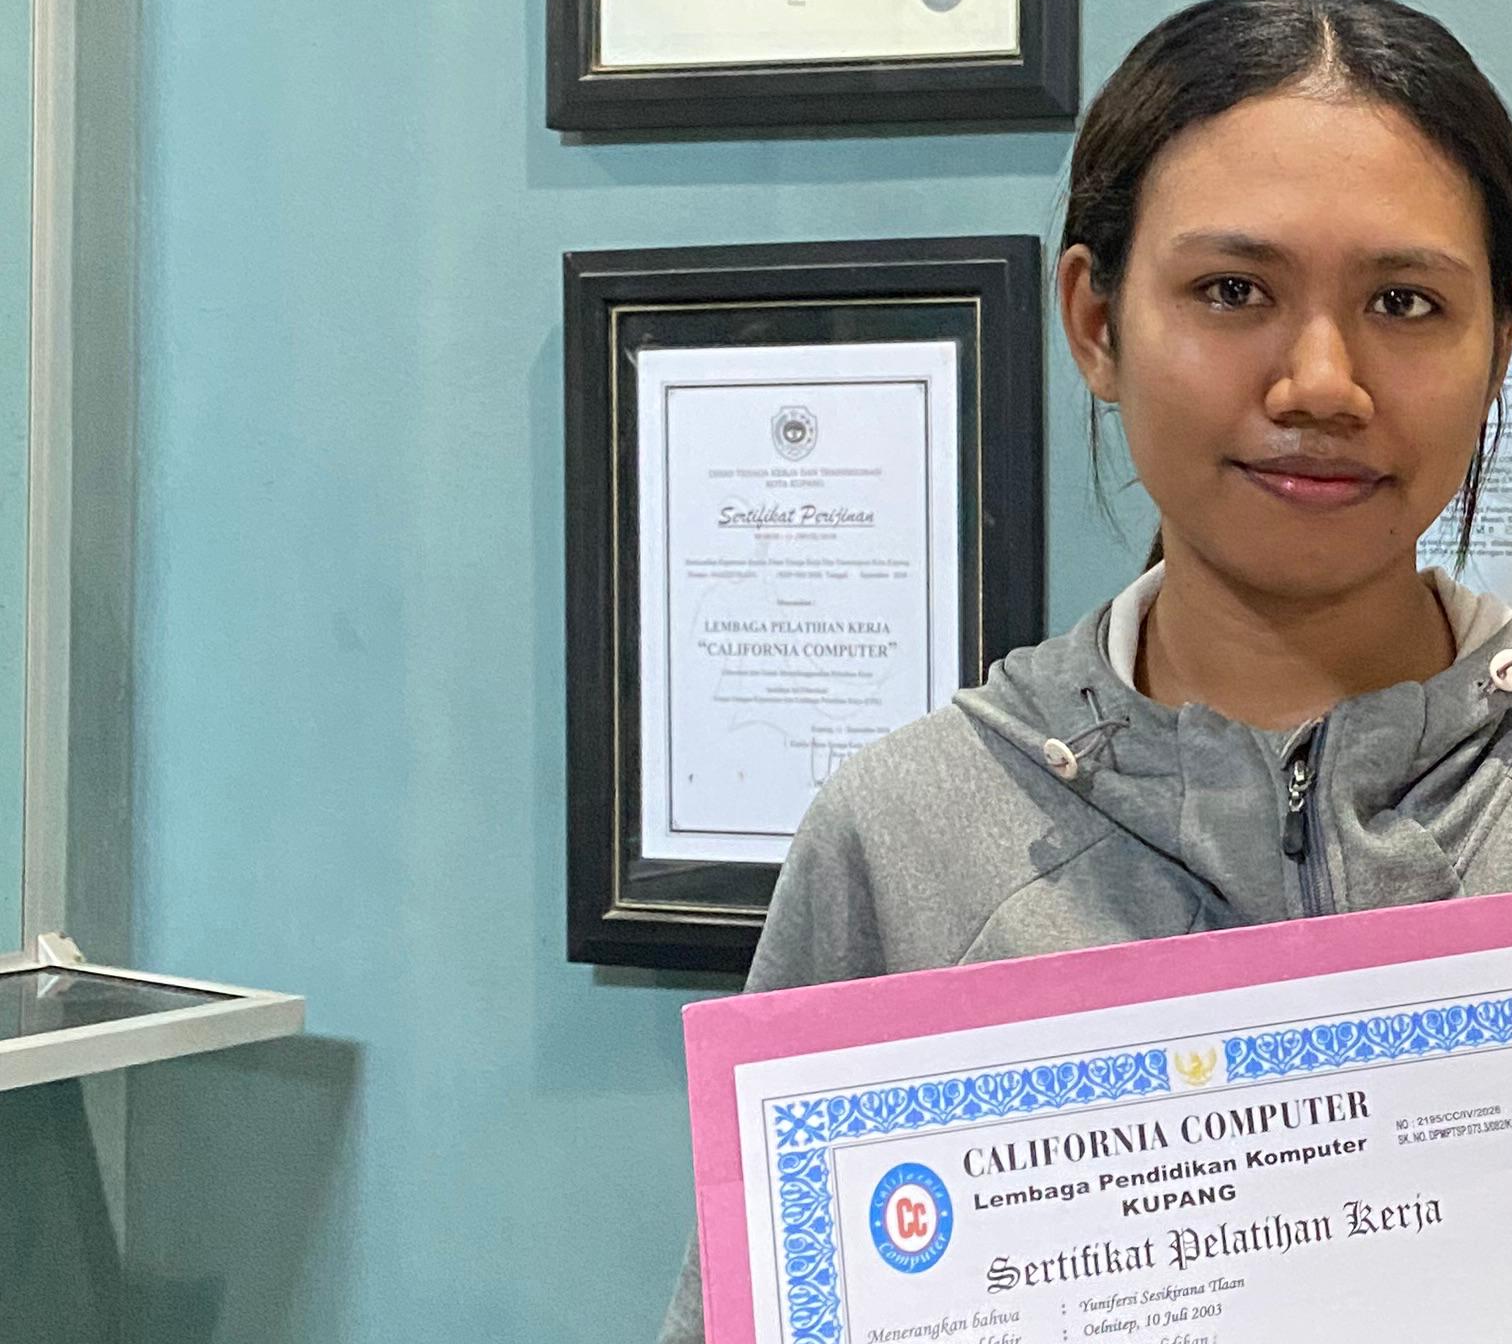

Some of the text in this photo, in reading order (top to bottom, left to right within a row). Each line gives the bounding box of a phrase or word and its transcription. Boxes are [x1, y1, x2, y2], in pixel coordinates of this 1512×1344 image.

[718, 504, 874, 529] Sertifikat Perijinan
[704, 620, 891, 634] LEMBAGA PELATIHAN KERJA
[963, 1089, 1372, 1179] CALIFORNIA COMPUTER
[973, 1135, 1368, 1211] Lembaga Pendidikan Komputer
[1121, 1183, 1237, 1217] KUPANG
[986, 1192, 1443, 1295] Sertifikat Pelatihan Kerja
[867, 1316, 968, 1344] Menerangkan
[972, 1310, 1021, 1329] bahwa
[1079, 1292, 1139, 1314] Yunifersi
[1140, 1284, 1205, 1306] Sesikirana
[1146, 1312, 1161, 1328] 10
[1162, 1306, 1189, 1327] Juli
[1191, 1302, 1223, 1321] 2003
